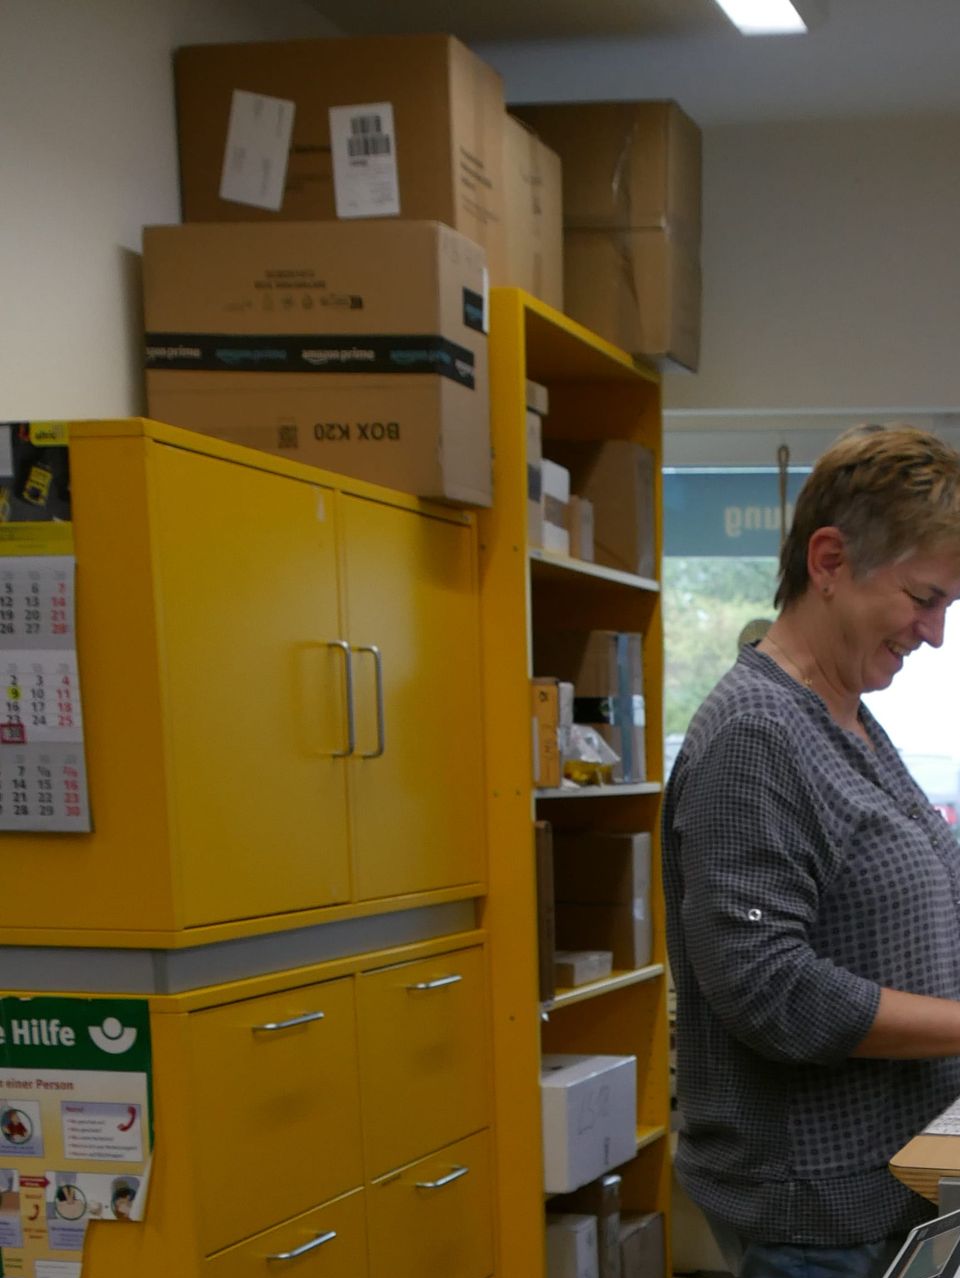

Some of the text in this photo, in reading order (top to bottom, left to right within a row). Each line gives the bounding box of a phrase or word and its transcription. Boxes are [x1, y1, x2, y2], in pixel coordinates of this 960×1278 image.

[314, 422, 400, 441] BOX K20
[11, 687, 19, 698] 9
[31, 688, 45, 698] 10
[31, 702, 45, 712] 17
[12, 1019, 76, 1046] Hilfe
[7, 1079, 73, 1090] einer Person
